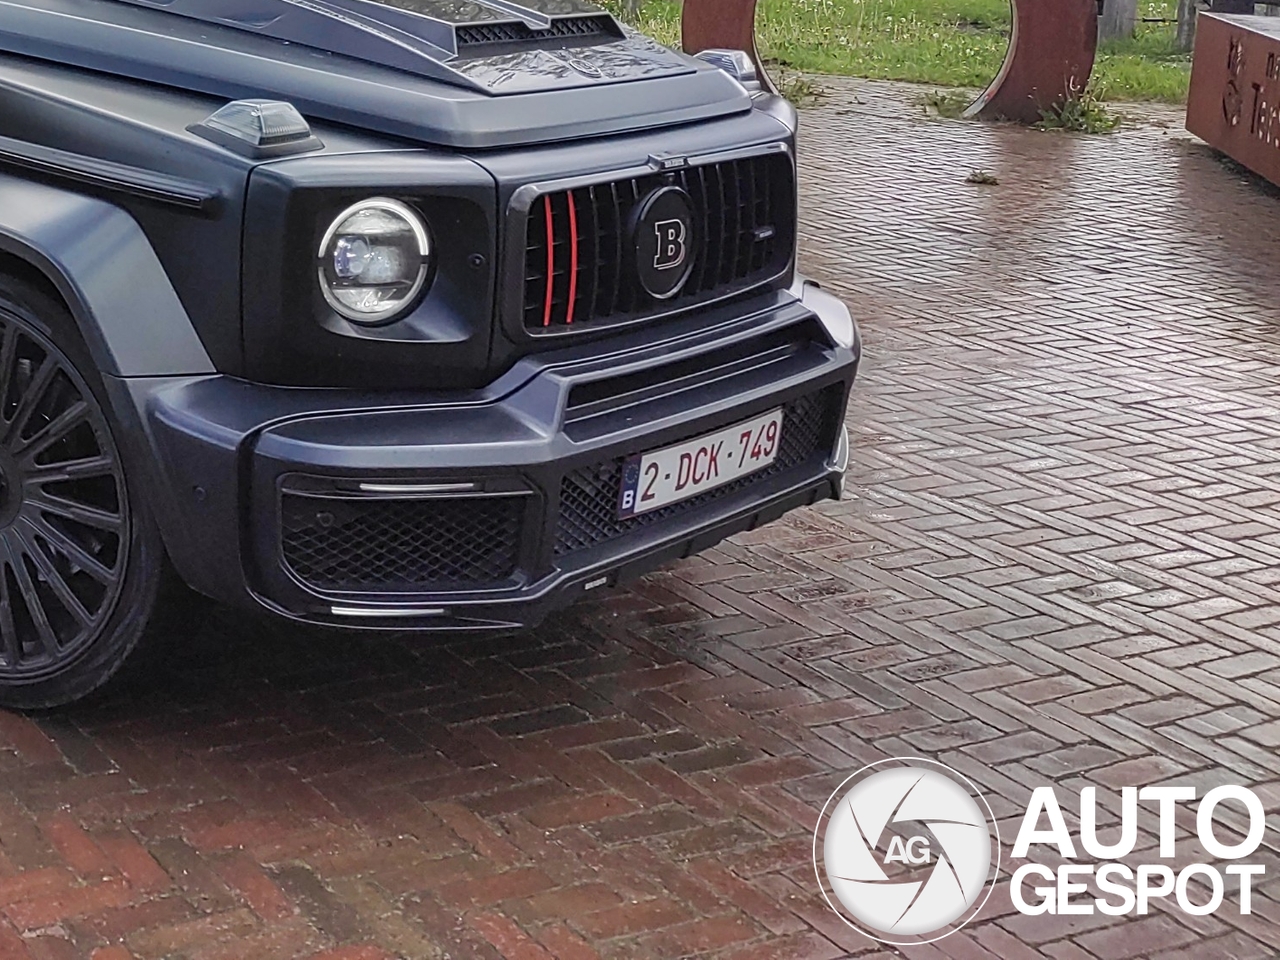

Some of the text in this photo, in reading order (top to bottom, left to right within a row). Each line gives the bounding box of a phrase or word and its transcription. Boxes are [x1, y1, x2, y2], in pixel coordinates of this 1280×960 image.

[654, 218, 687, 270] B
[621, 420, 778, 510] B 2-DCK-749
